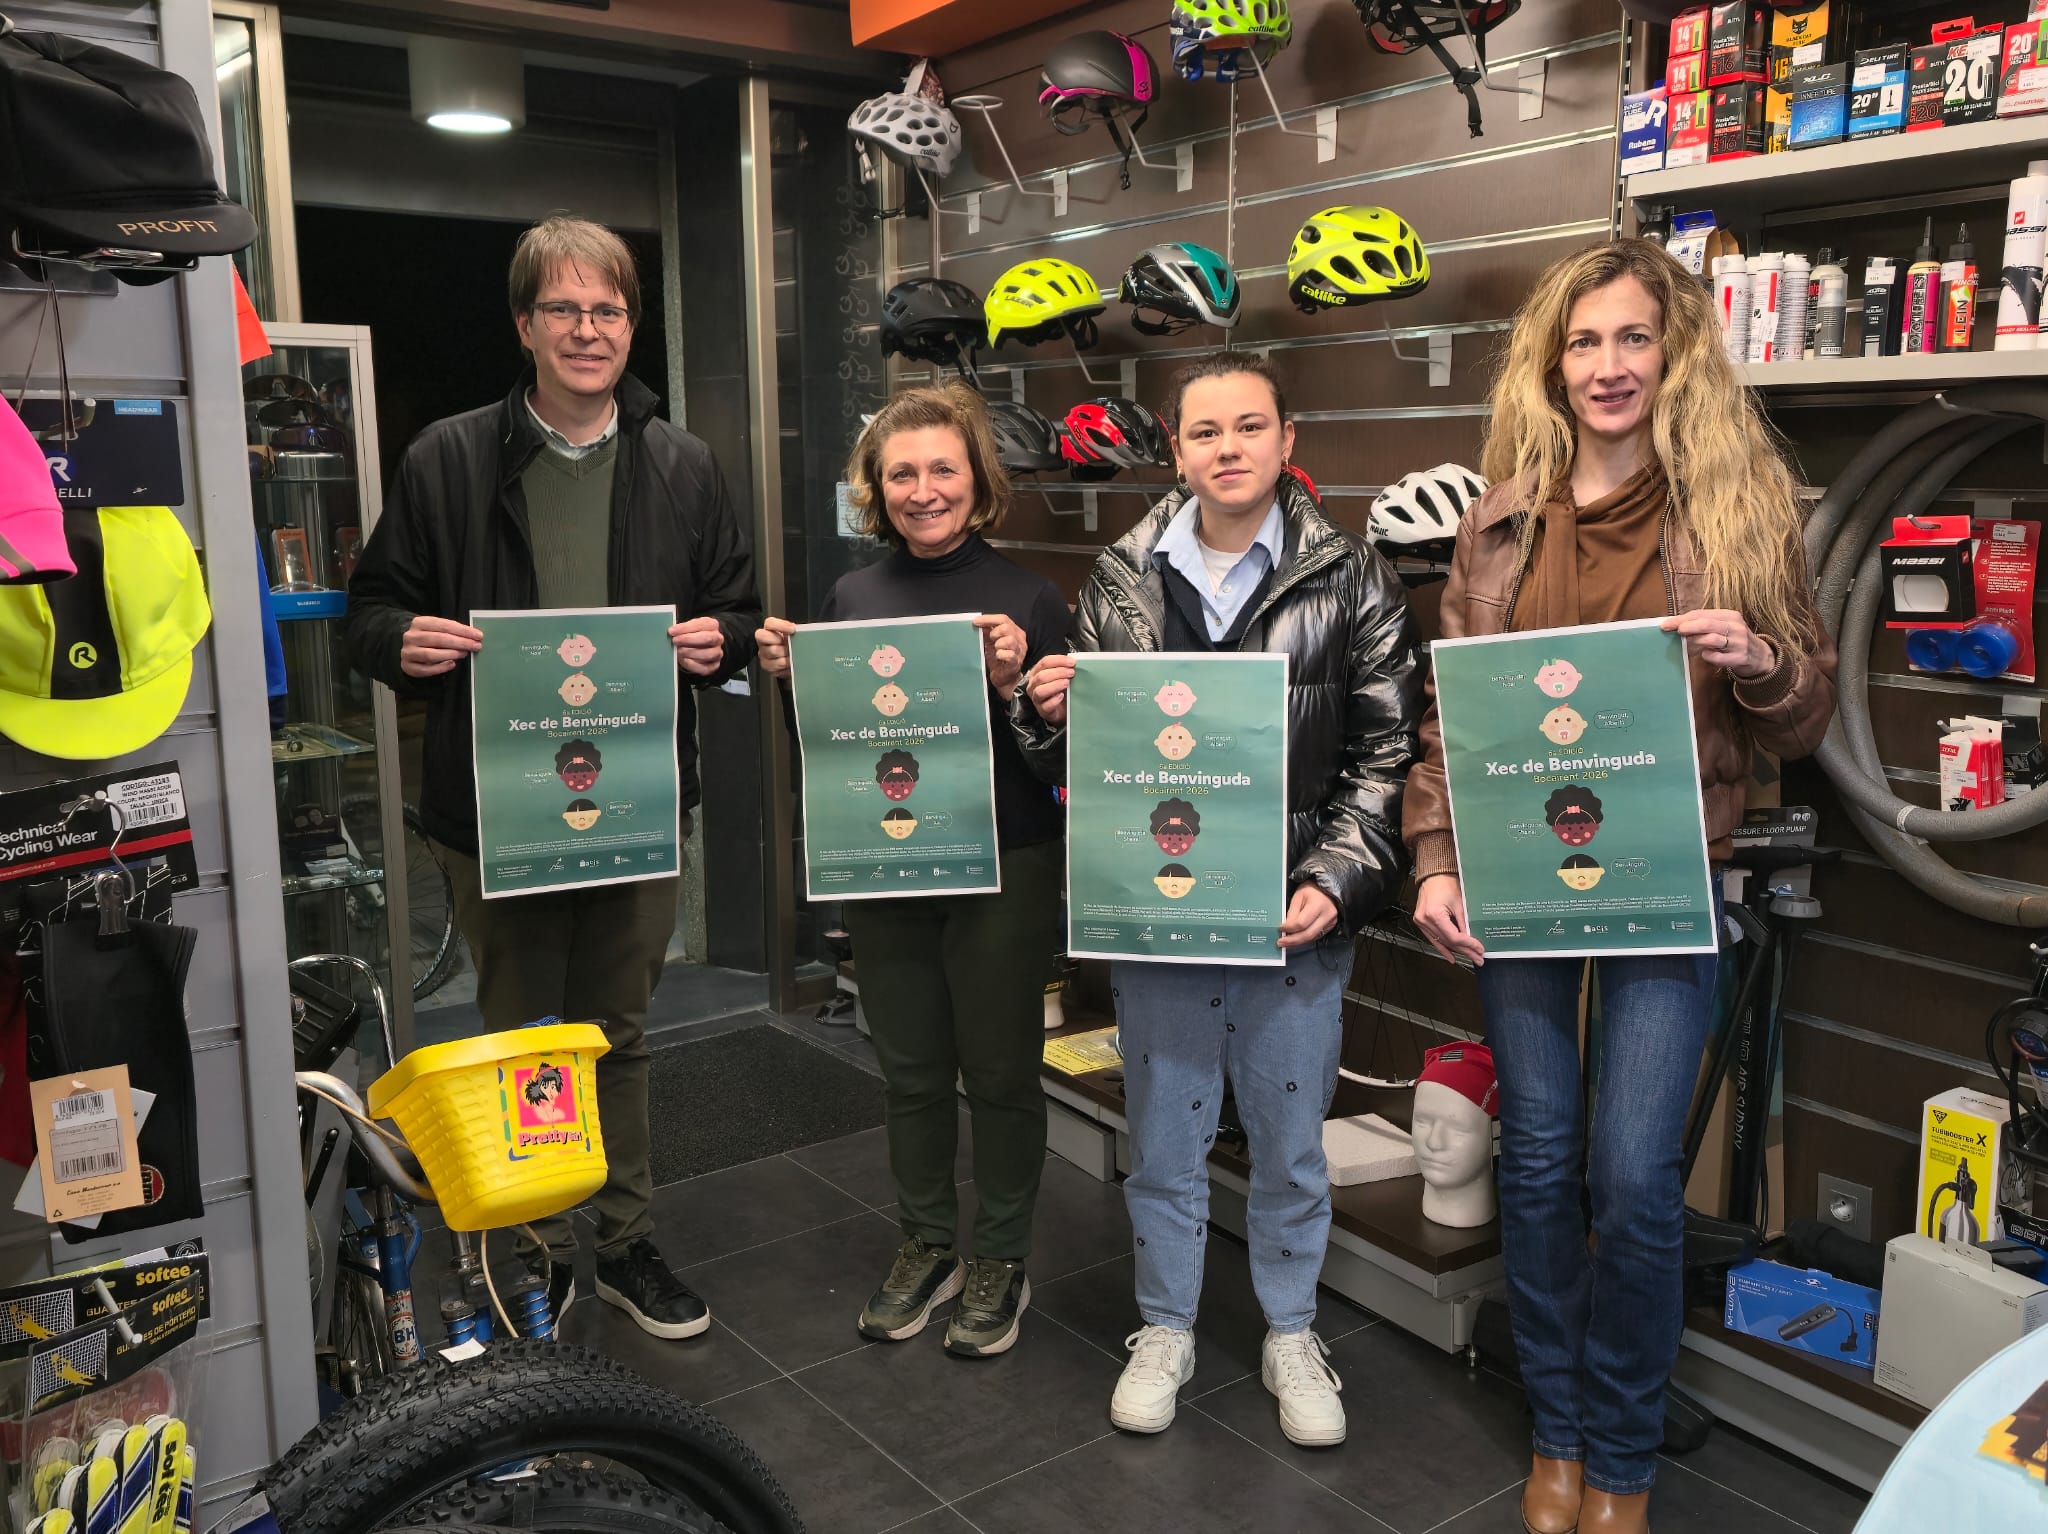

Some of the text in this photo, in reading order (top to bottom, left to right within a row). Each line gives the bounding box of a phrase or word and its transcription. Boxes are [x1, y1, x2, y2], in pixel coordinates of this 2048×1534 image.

[1944, 58, 1985, 105] 20
[1800, 87, 1836, 100] INNER TUBE
[117, 219, 218, 237] PROFIT
[1004, 295, 1035, 309] LAZER
[1301, 284, 1347, 306] catlike
[54, 487, 92, 498] ELLI
[75, 647, 95, 664] R
[509, 713, 647, 732] Xec de Benvinguda
[547, 728, 608, 738] Bocairent 2026
[831, 723, 960, 741] Xec de Benvinguda
[867, 738, 925, 748] Bocairent 2026
[1485, 751, 1657, 777] Xec de Benvinguda
[1102, 769, 1251, 788] Xec de Benvinguda
[1533, 769, 1609, 783] Bocairent 2026
[1143, 786, 1184, 795] Bocairent
[56, 830, 99, 847] Wear
[1762, 826, 1785, 834] FLOOR
[1785, 825, 1807, 833] PUMP
[517, 1129, 568, 1147] Pretty
[135, 1264, 191, 1286] Softee
[86, 1299, 138, 1318] GUATES
[152, 1287, 188, 1317] Softee
[153, 1324, 164, 1336] DE
[164, 1305, 196, 1331] PORTERO
[394, 1326, 415, 1344] BH
